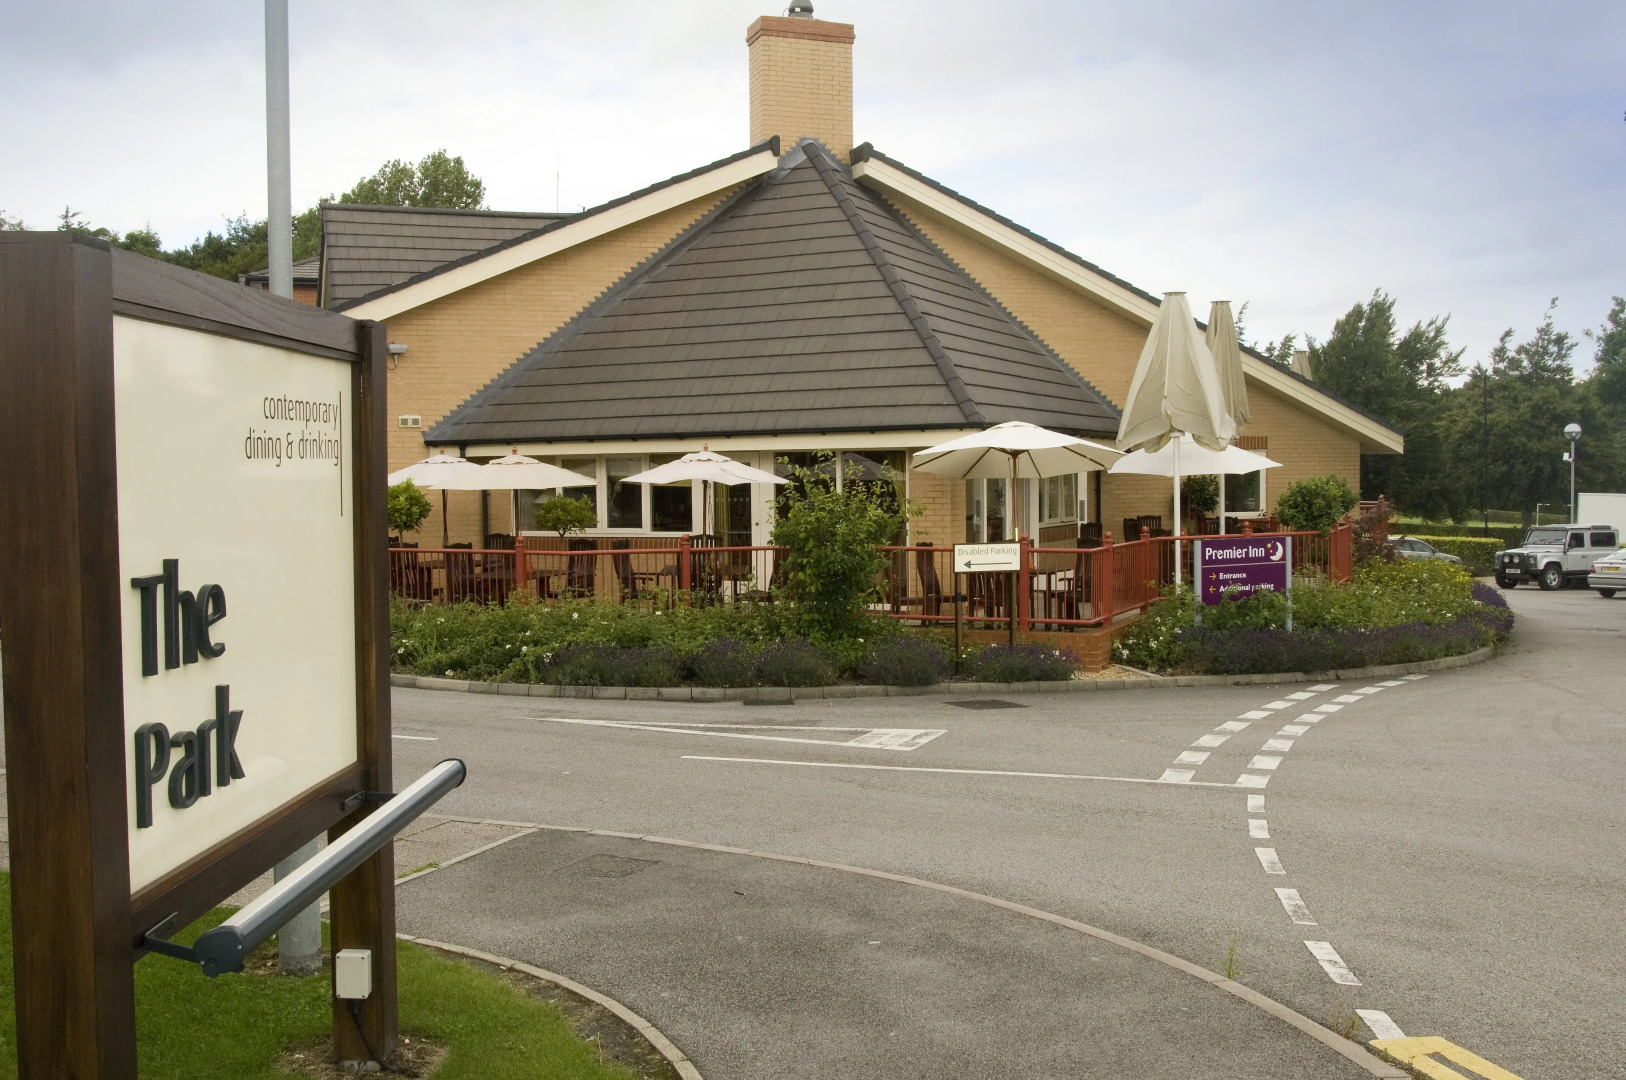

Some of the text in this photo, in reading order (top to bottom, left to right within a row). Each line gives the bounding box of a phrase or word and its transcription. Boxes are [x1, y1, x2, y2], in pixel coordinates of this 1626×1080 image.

[264, 394, 338, 431] contemporary
[245, 427, 339, 467] dining & drinking
[957, 547, 1017, 557] Disabled Parking
[1205, 545, 1265, 560] Premier Inn
[1219, 572, 1247, 580] Entrance
[1219, 583, 1250, 593] Adonal
[131, 558, 227, 677] The
[135, 684, 246, 829] Park
